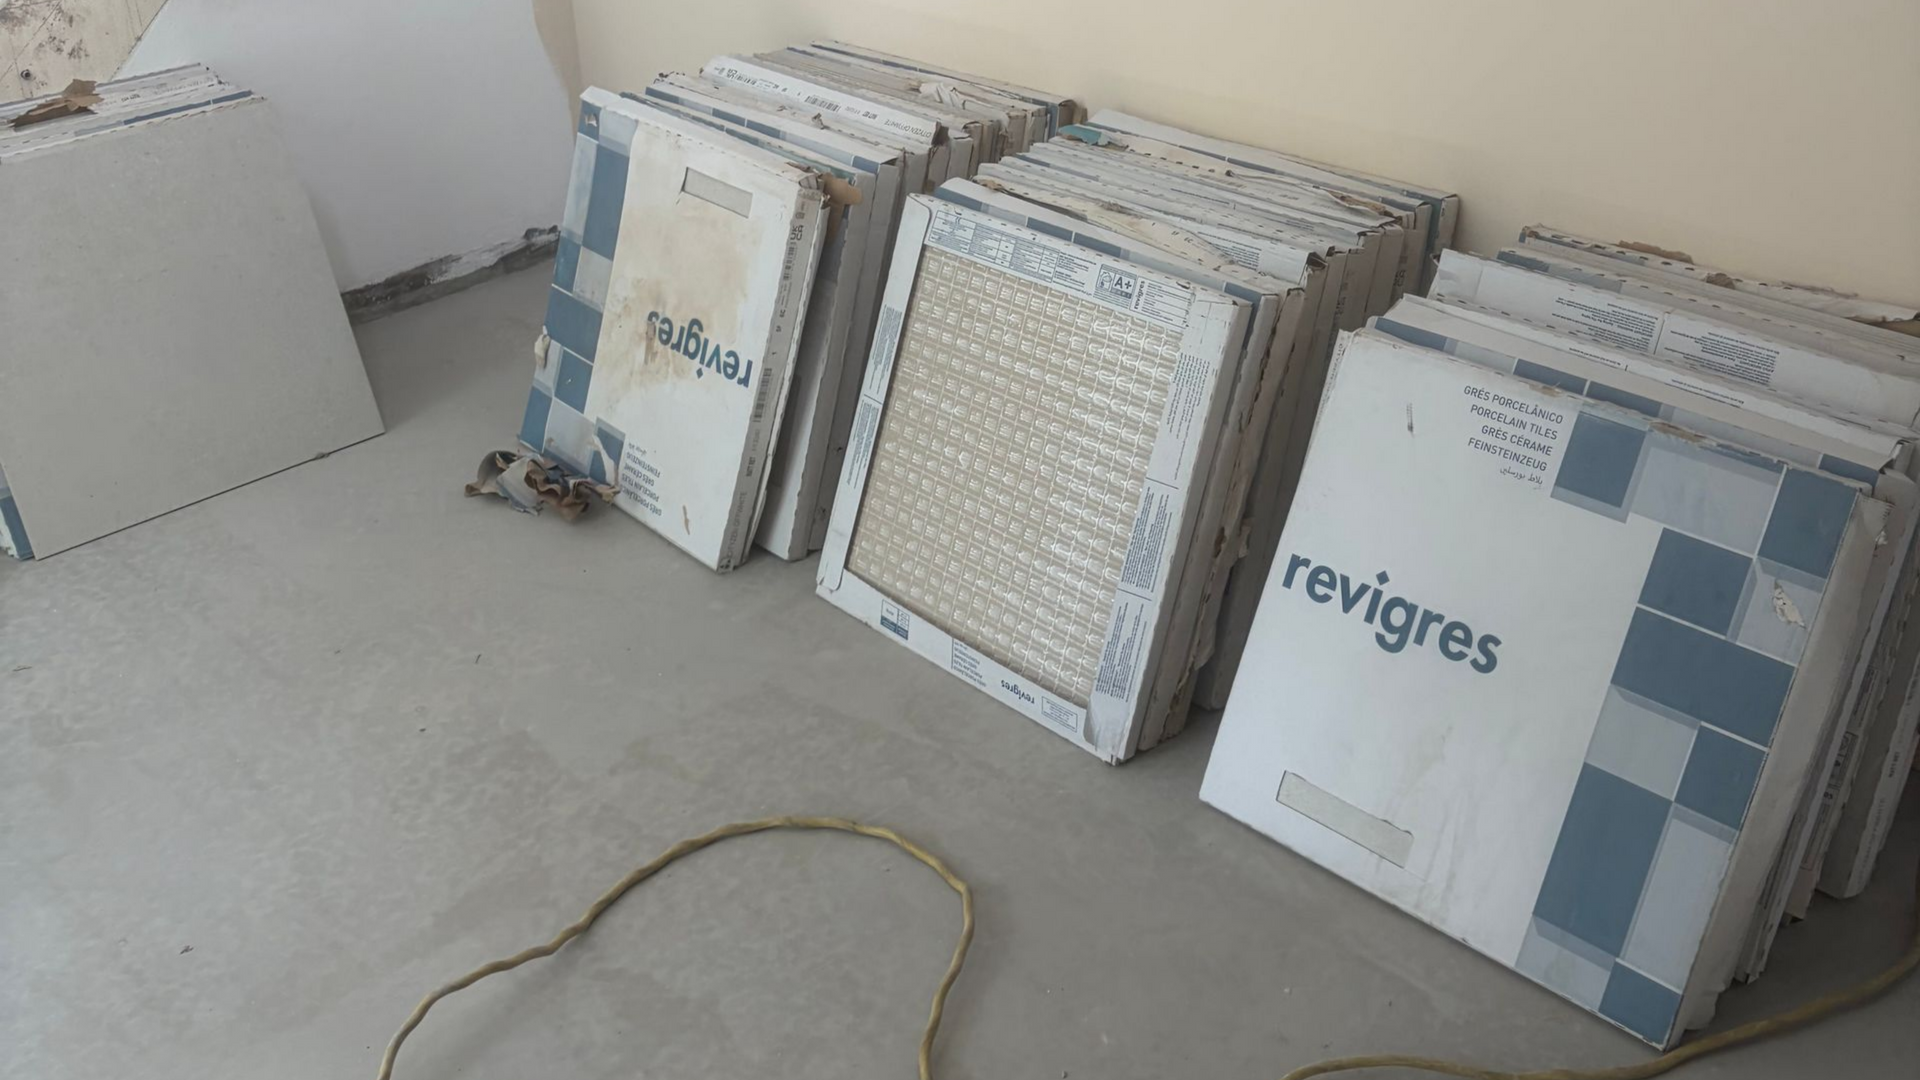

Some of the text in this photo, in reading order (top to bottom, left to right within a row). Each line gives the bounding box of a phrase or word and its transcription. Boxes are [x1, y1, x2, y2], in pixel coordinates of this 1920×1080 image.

[1114, 276, 1133, 291] A+
[1134, 280, 1146, 310] revigres
[1463, 385, 1491, 401] GRÉS
[1470, 404, 1558, 440] PORCELAIN TILES
[1467, 437, 1548, 472] FEINSTEINZEUG
[1510, 434, 1553, 456] CÉRAME
[1282, 553, 1502, 673] revigres
[1000, 679, 1035, 705] revigres
